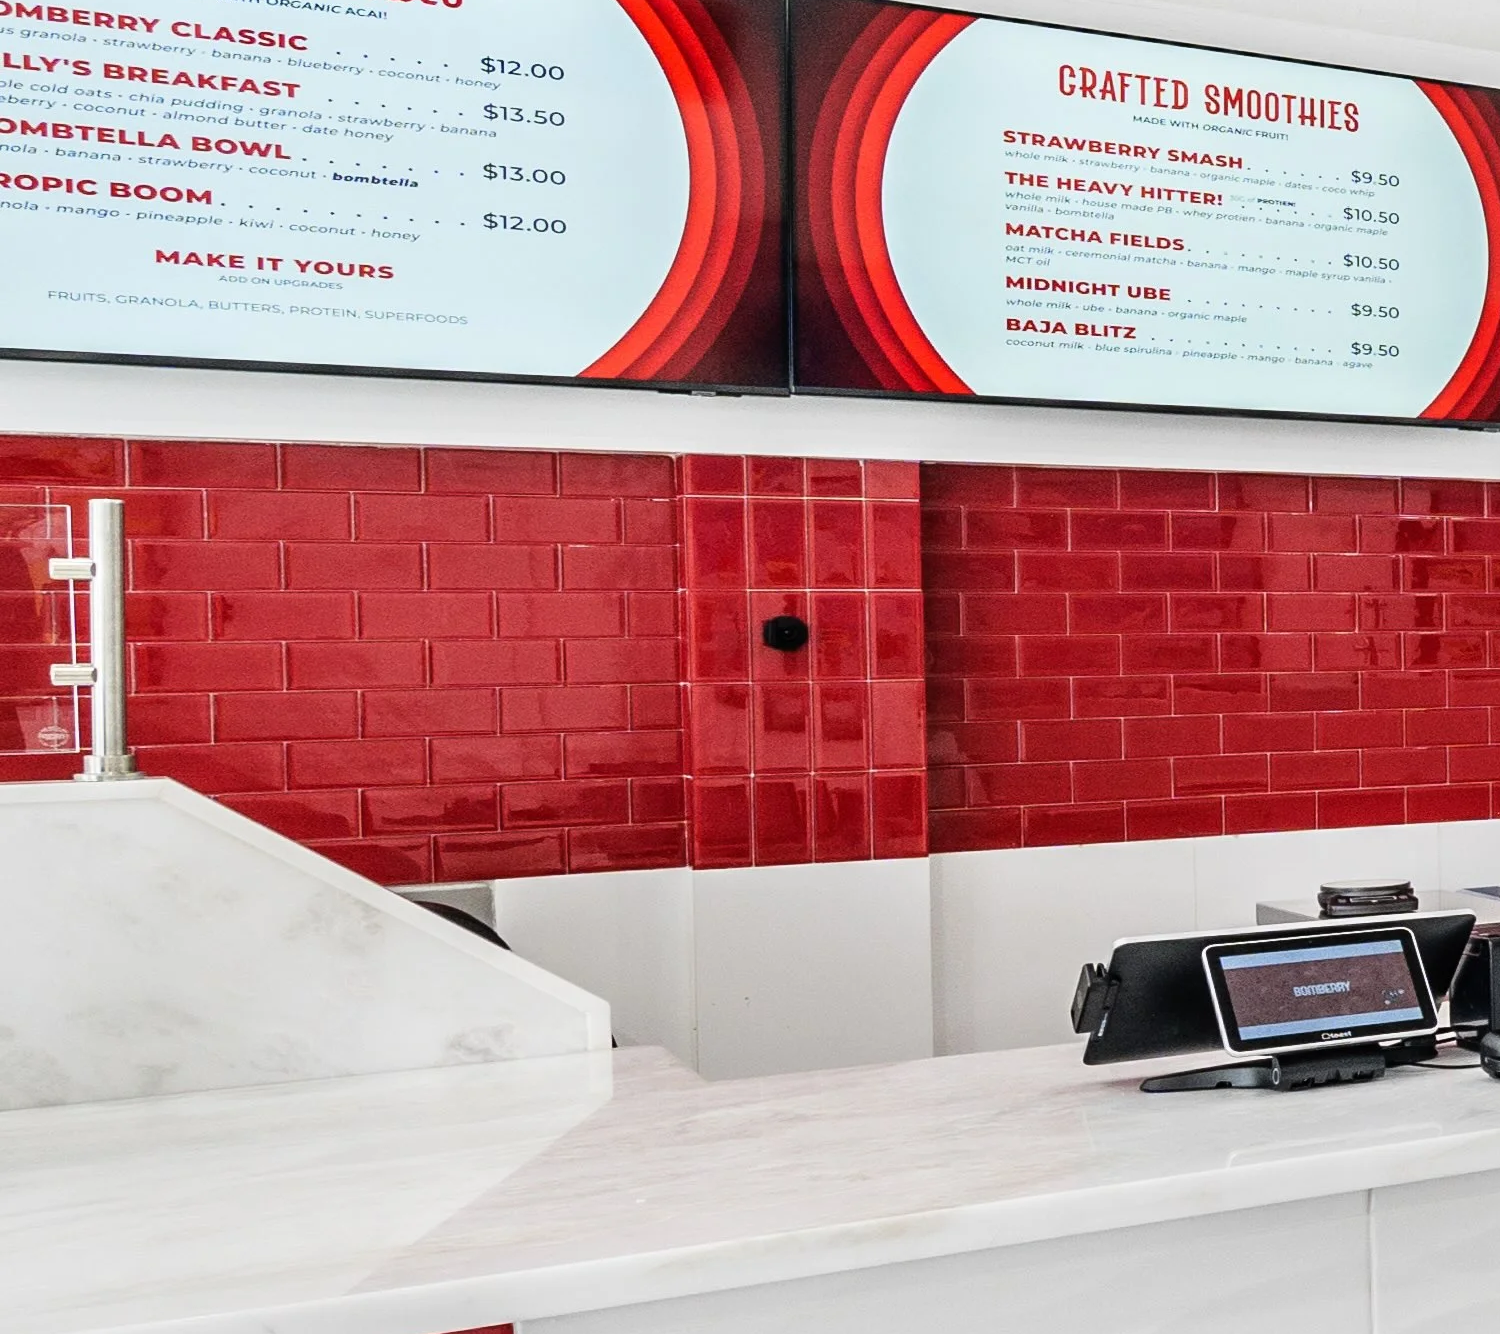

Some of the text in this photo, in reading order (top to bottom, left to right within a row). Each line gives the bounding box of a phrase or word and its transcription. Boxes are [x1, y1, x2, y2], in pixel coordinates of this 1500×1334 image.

[345, 7, 387, 19] ACAI!
[20, 29, 87, 42] granola
[103, 39, 196, 56] strawberry
[212, 49, 271, 63] banana
[288, 58, 364, 75] blueberry
[379, 70, 440, 82] coconut
[455, 77, 500, 91] honey
[171, 22, 307, 50] CLASSIC
[481, 56, 564, 80] $12.00
[3, 53, 565, 126] LLY'S BREAKFAST $13.50
[1059, 64, 1359, 131] CRAFTED SMOOTHIES
[30, 84, 68, 94] cold
[74, 88, 112, 98] oats
[129, 93, 164, 104] chia
[171, 98, 243, 114] pudding
[259, 107, 322, 120] granola
[338, 115, 425, 132] strawberry
[440, 124, 496, 138] banana
[73, 103, 145, 117] coconut
[163, 111, 229, 125] almond
[234, 117, 287, 130] butter
[302, 125, 338, 135] date
[344, 128, 394, 143] honey
[56, 148, 121, 161] banana
[139, 157, 232, 173] strawberry
[249, 167, 315, 179] coconut
[332, 172, 418, 188] bombtella
[192, 137, 291, 159] BOWL
[483, 163, 565, 185] $13.00
[1004, 130, 1399, 187] STRAWBERRY SMASH $9.50
[110, 182, 212, 204] BOOM
[484, 213, 566, 234] $12.00
[1005, 171, 1048, 188] THE
[1057, 178, 1133, 196] HEAVY
[1141, 186, 1222, 206] HITTER!
[1344, 207, 1399, 224] $10.50
[56, 205, 120, 218] mango
[136, 211, 223, 225] pineapple
[239, 218, 274, 229] kiwi
[289, 224, 355, 235] coconut
[371, 229, 420, 242] honey
[156, 250, 394, 279] MAKE IT YOURS
[218, 275, 343, 290] ADD ON UPGRADES
[1344, 254, 1399, 271] $10.50
[48, 290, 468, 325] FRUITS, GRANOLA, BUTTERS, PROTEIN, SUPERFOODS
[1006, 276, 1399, 319] MIDNIGHT UBE $9.50
[1007, 318, 1399, 357] BAJA BLITZ $9.50
[1293, 980, 1350, 997] BOMBERRY
